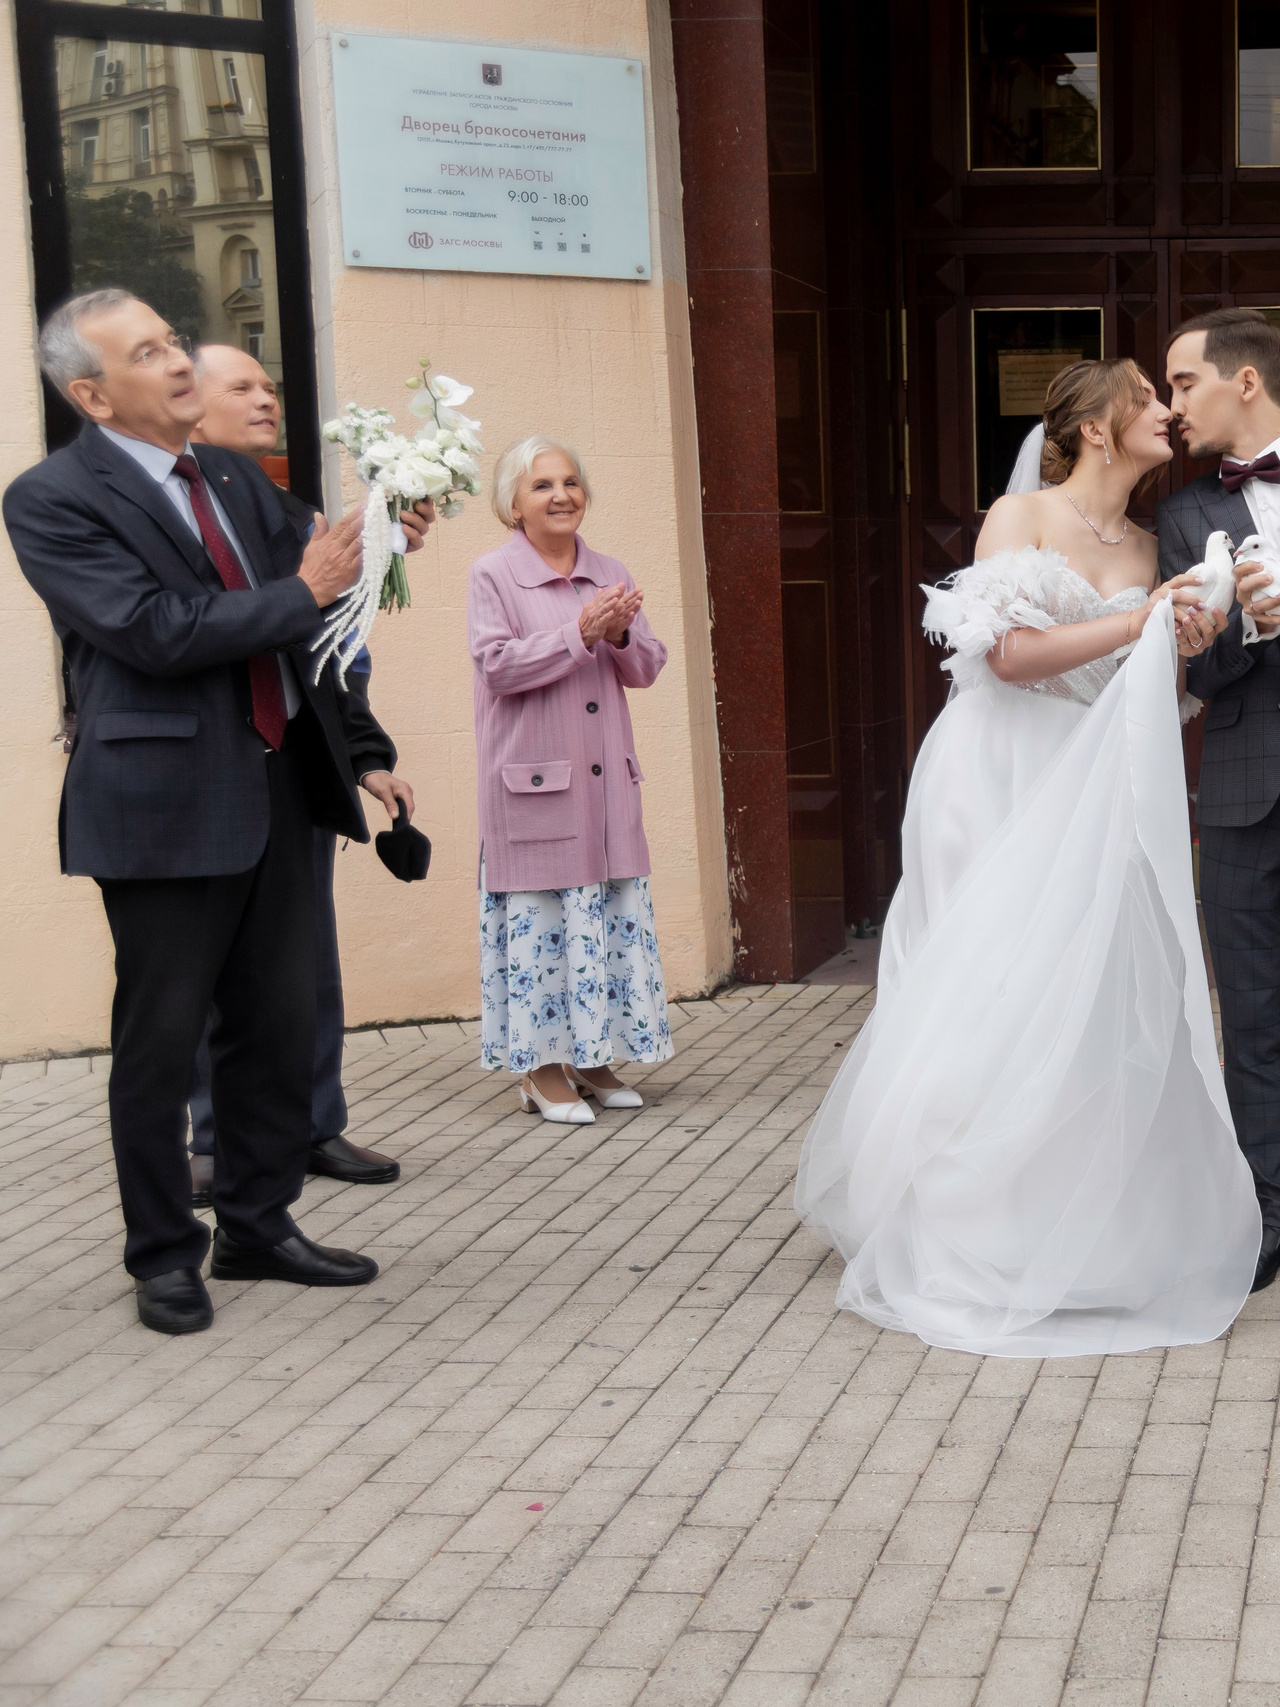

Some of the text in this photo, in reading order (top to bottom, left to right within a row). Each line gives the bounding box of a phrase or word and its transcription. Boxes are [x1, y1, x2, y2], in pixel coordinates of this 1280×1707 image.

[469, 102, 492, 110] ГОРОДА
[401, 115, 586, 142] Дворец бракосочетания
[440, 163, 554, 183] РЕЖИМ РАБОТЫ
[508, 190, 538, 204] 9:00
[553, 193, 589, 207] 18:00
[406, 208, 447, 216] ВОСКРЕСЕНЬЕ
[452, 211, 498, 219] ПОНЕДЕЛЬНИК
[439, 238, 503, 248] ЗАГС МОСКВЫ
